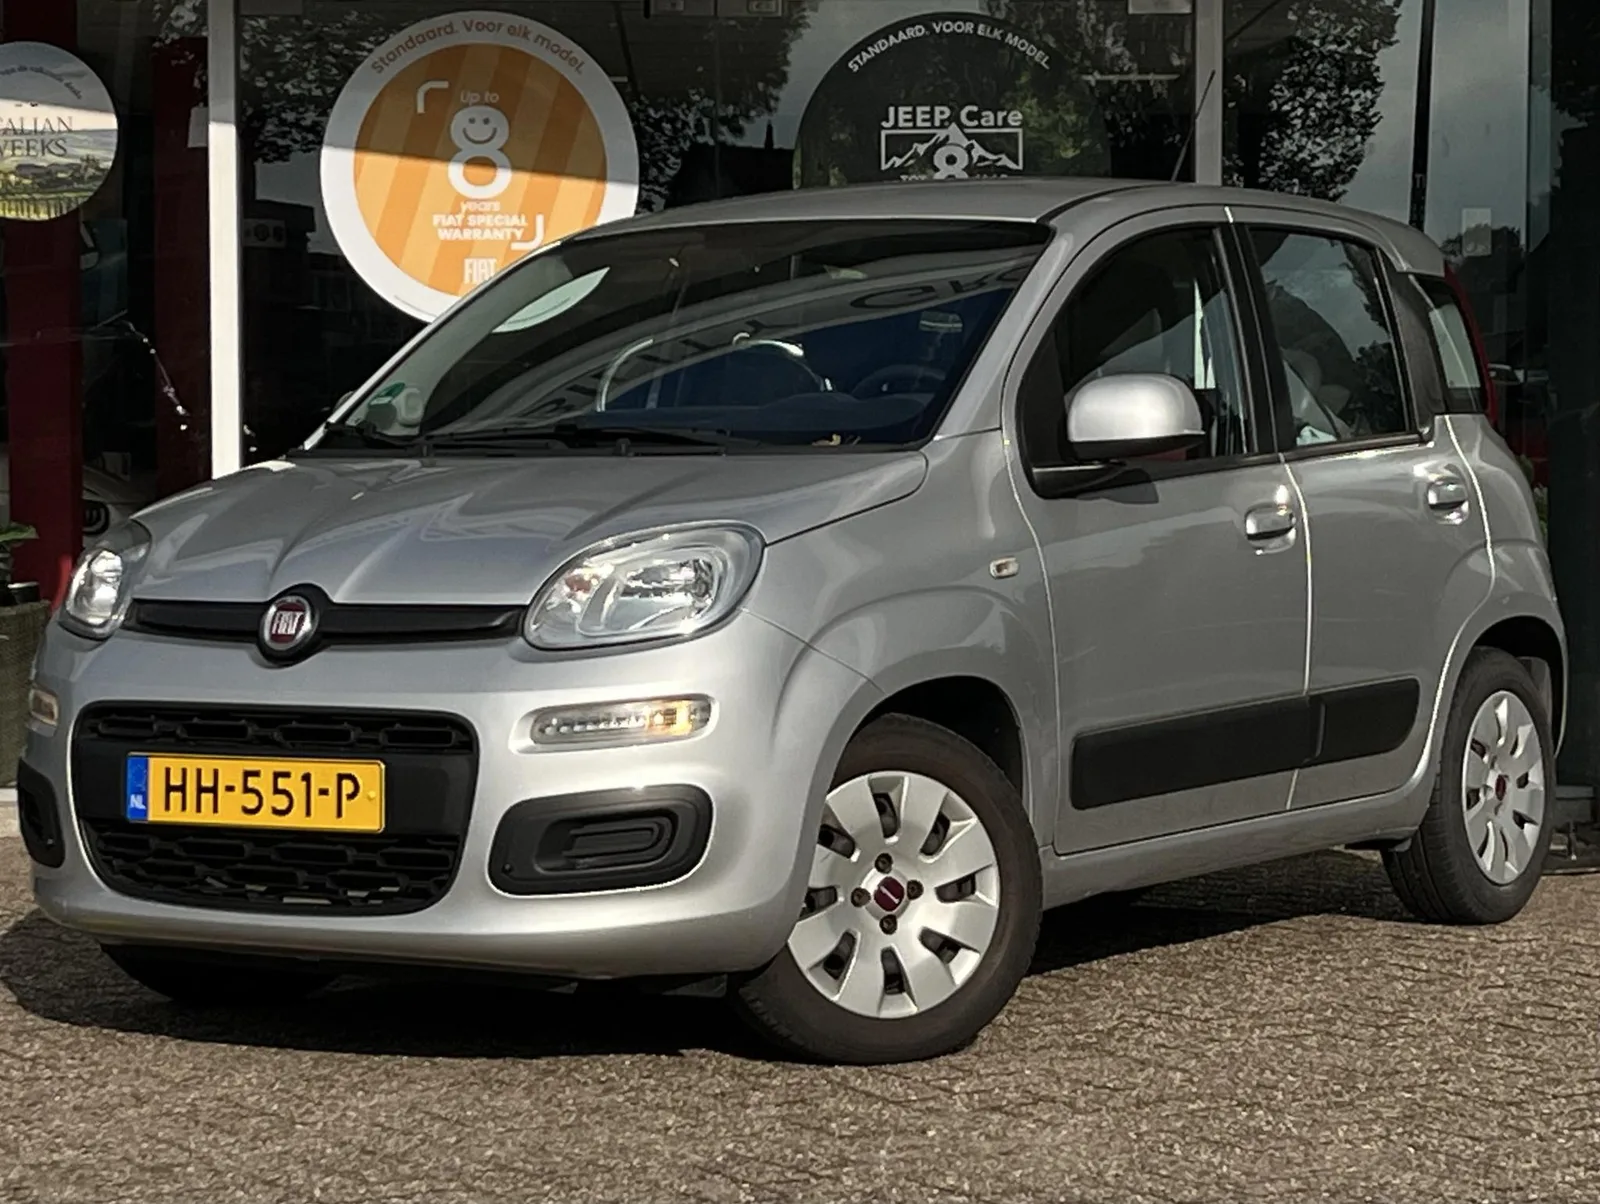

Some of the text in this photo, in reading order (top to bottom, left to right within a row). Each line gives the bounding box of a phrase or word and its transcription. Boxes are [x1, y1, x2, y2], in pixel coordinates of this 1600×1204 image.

[371, 21, 459, 74] Standaard.
[462, 20, 505, 33] Voor
[507, 24, 532, 41] elk
[847, 21, 1051, 73] STANDAARD. VOOR ELK MODEL
[460, 90, 500, 106] Up to
[0, 115, 73, 136] ALIAN
[959, 104, 1023, 127] Care
[460, 200, 501, 216] years
[432, 214, 528, 227] FIAT SPECIAL
[437, 227, 525, 241] WARRANTY
[463, 257, 497, 285] FIAT
[271, 610, 305, 635] FIAT
[130, 793, 147, 810] NL
[164, 766, 361, 819] HH-551-P
